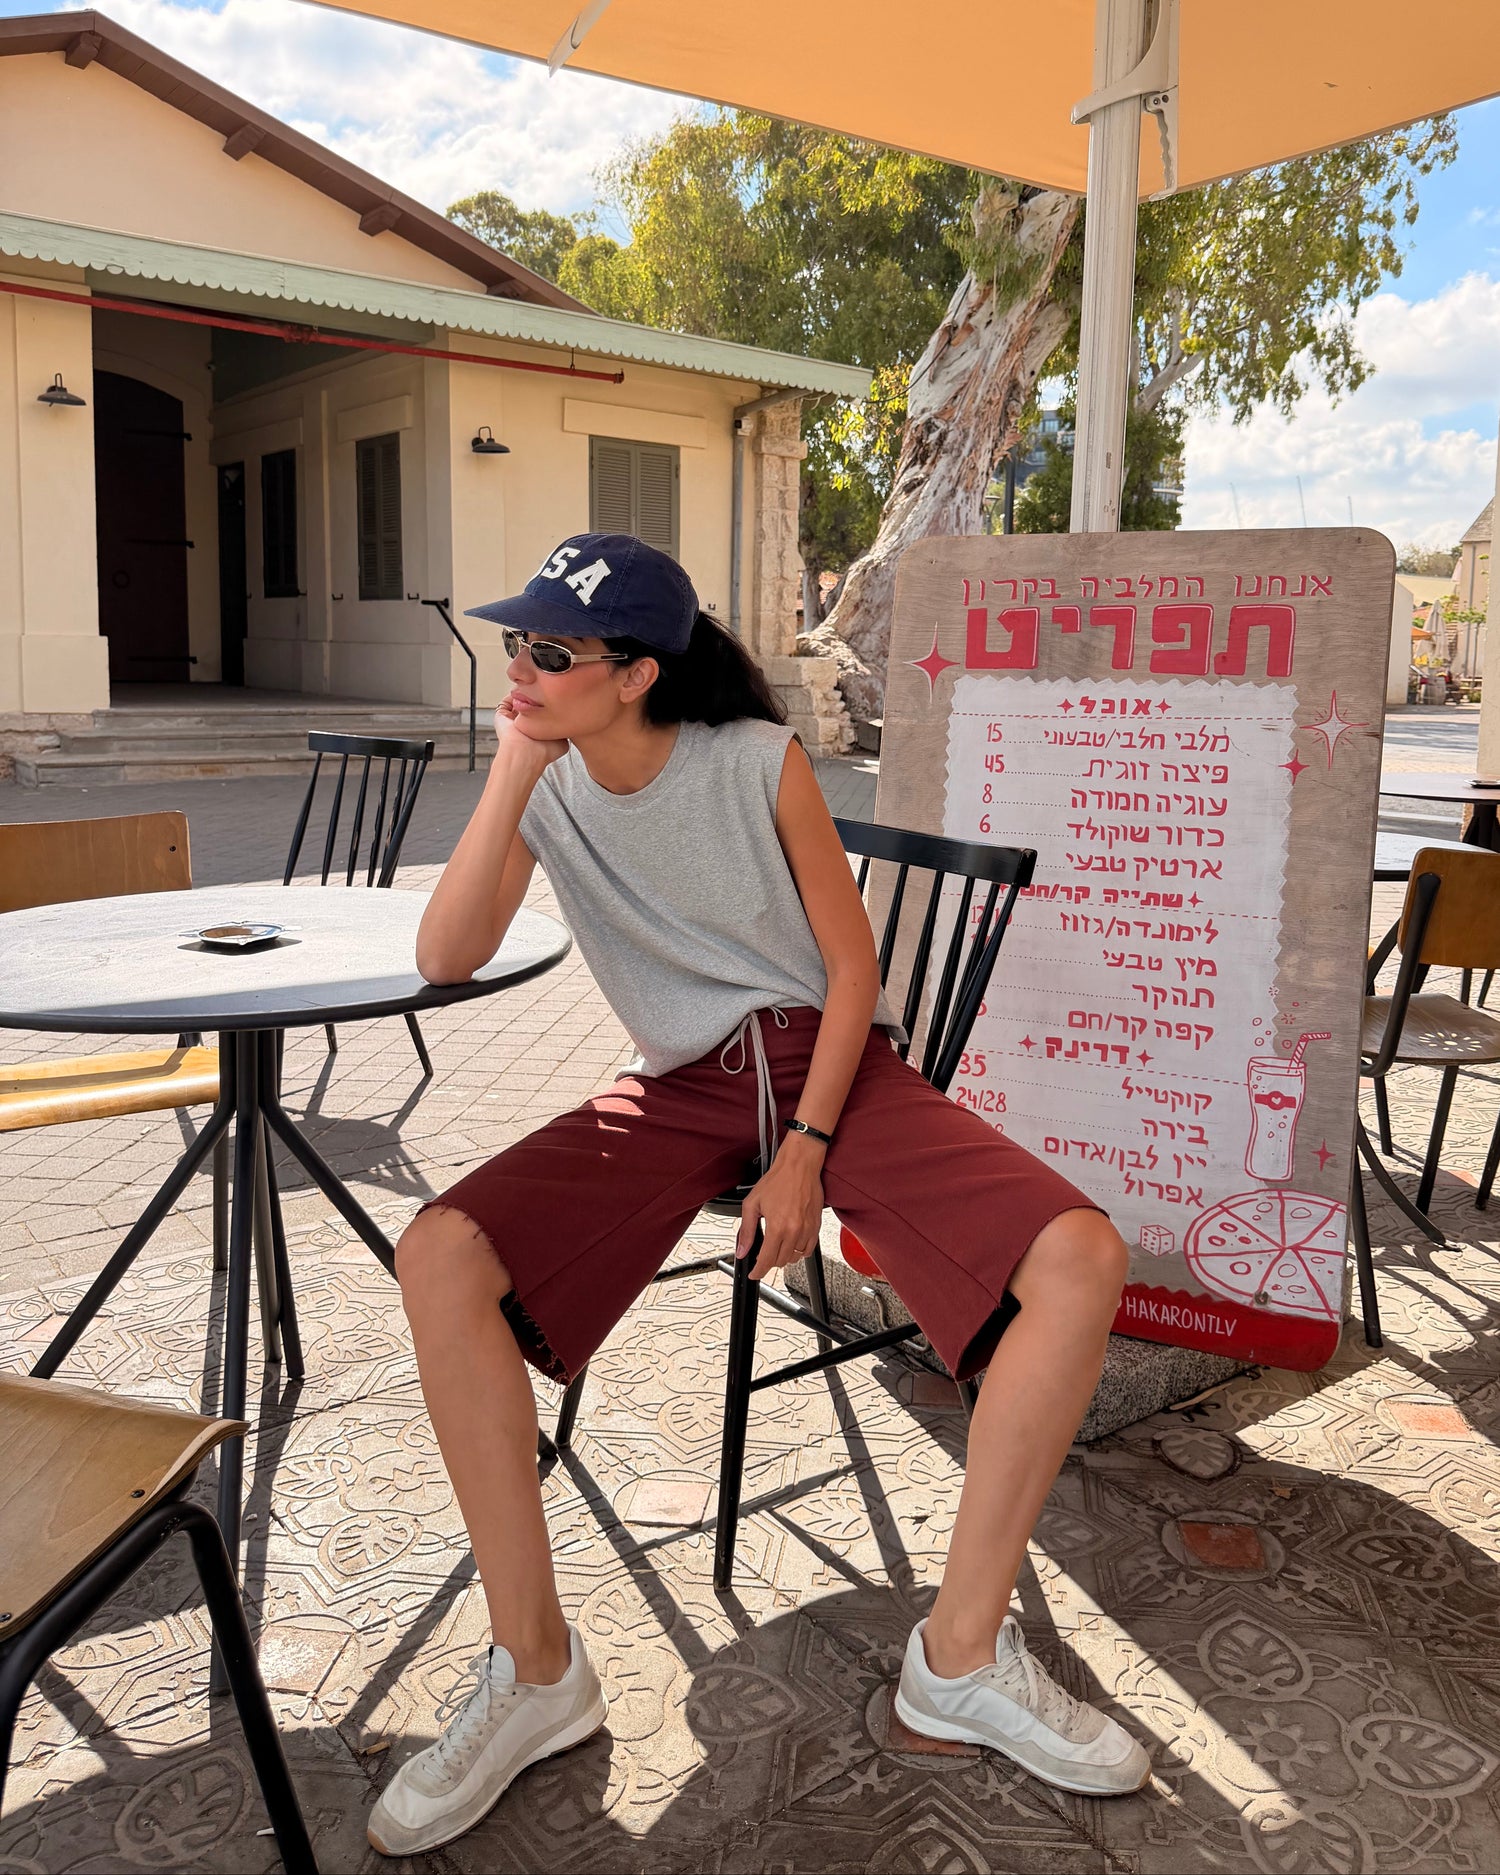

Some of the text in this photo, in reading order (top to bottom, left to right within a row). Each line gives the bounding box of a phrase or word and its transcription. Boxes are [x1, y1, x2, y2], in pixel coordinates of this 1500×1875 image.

[525, 547, 611, 606] SA
[962, 574, 1334, 606] אנחנו המלביה בקרון
[965, 603, 1296, 677] תפריט
[1079, 695, 1152, 716] אוכל
[986, 723, 1003, 743] 15
[1174, 725, 1231, 753] מלבי
[984, 754, 1229, 785] פיצה זוגית 45
[981, 783, 1228, 817] עוגיה חמודה 8
[978, 813, 1226, 849] כדור שוקולד 6
[1066, 852, 1223, 881] ארטיק טבעי
[1102, 887, 1184, 909] שתייה
[1102, 949, 1218, 982] מיץ טבעי
[1068, 1010, 1215, 1051] קפה קר/חם
[1045, 1036, 1130, 1065] דרינק
[958, 1052, 1213, 1116] קוקטייל 35
[955, 1086, 1209, 1146] בירה 24/28
[1043, 1136, 1208, 1179] יין לבן/אדום
[1123, 1171, 1206, 1209] אפרול
[1117, 1296, 1238, 1337] HAKARONTLV
